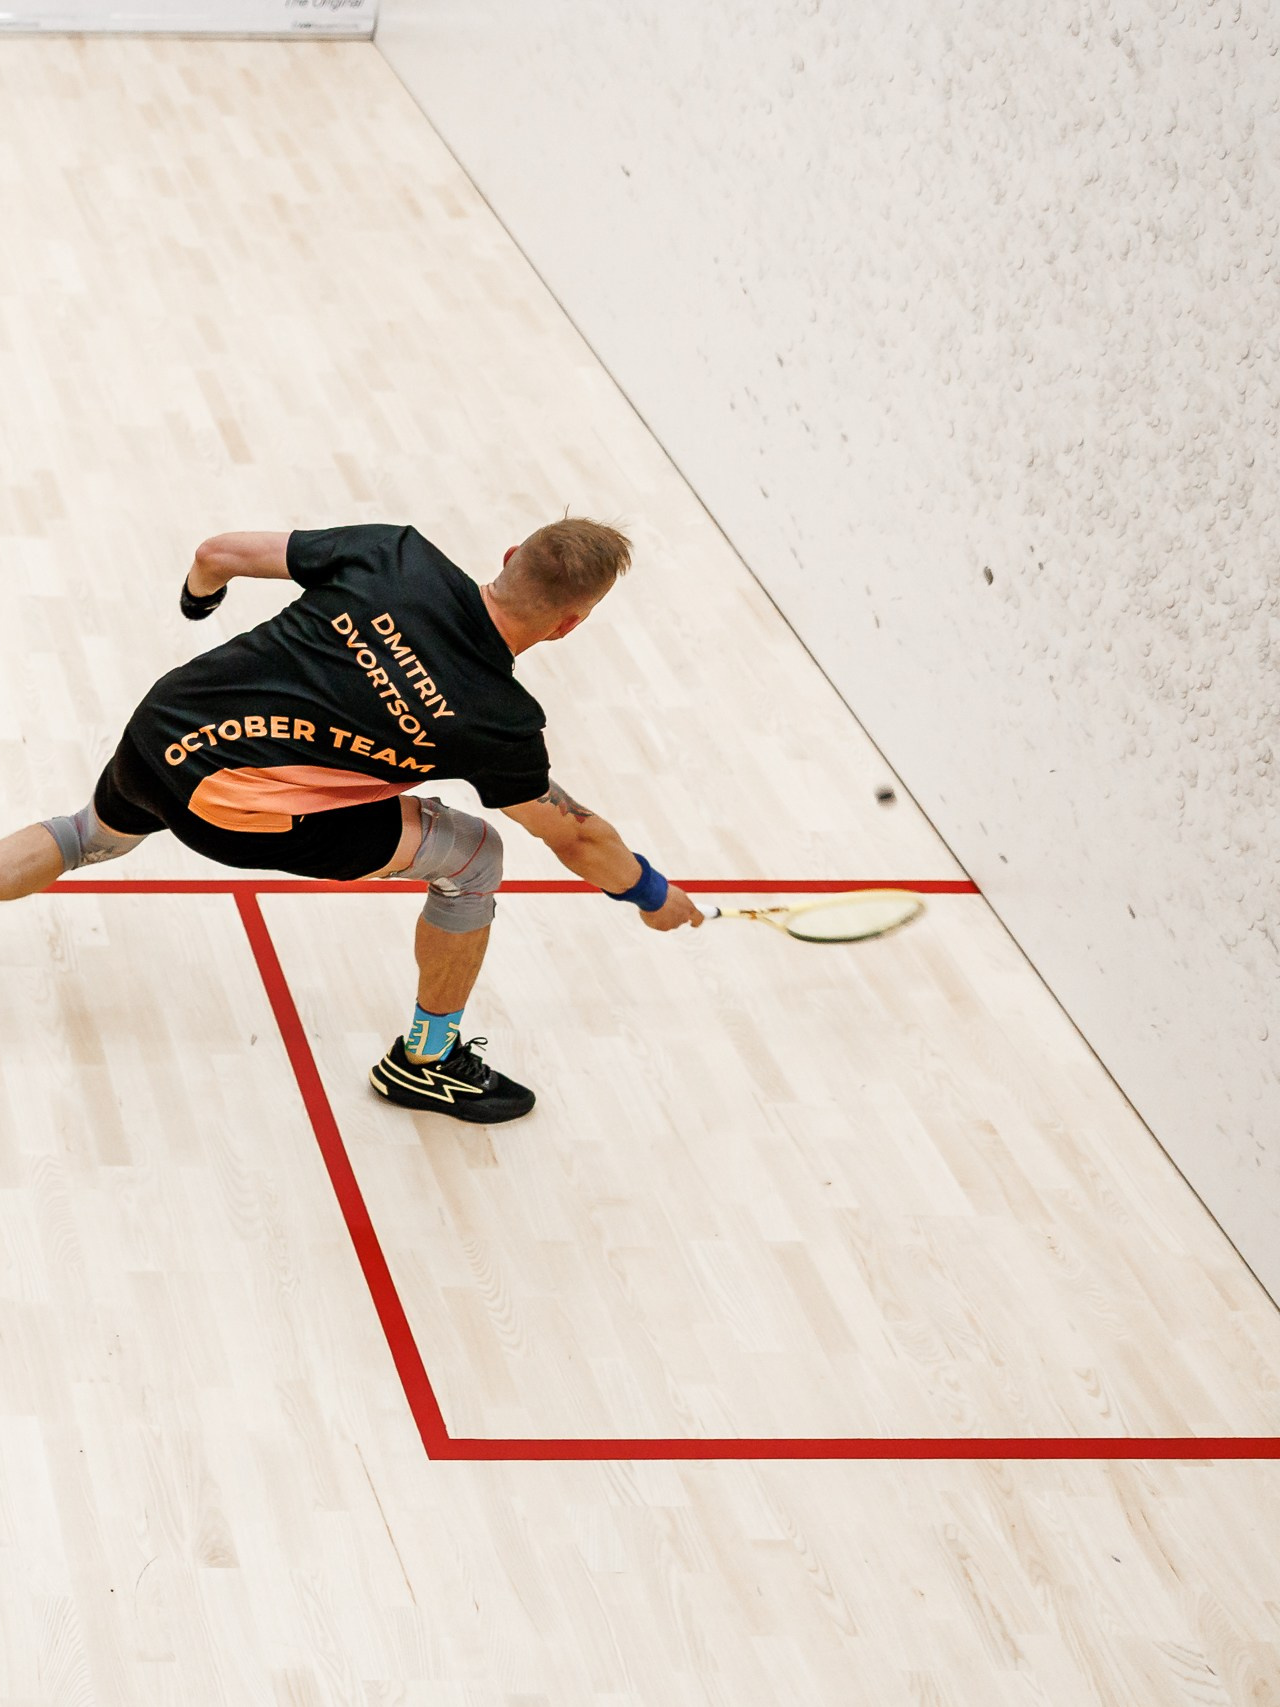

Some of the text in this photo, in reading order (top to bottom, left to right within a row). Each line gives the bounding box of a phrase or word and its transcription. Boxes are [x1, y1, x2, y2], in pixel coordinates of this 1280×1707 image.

[331, 612, 436, 748] DVORTSOV
[371, 612, 455, 719] DMITRIY
[164, 716, 436, 773] OCTOBER TEAM
